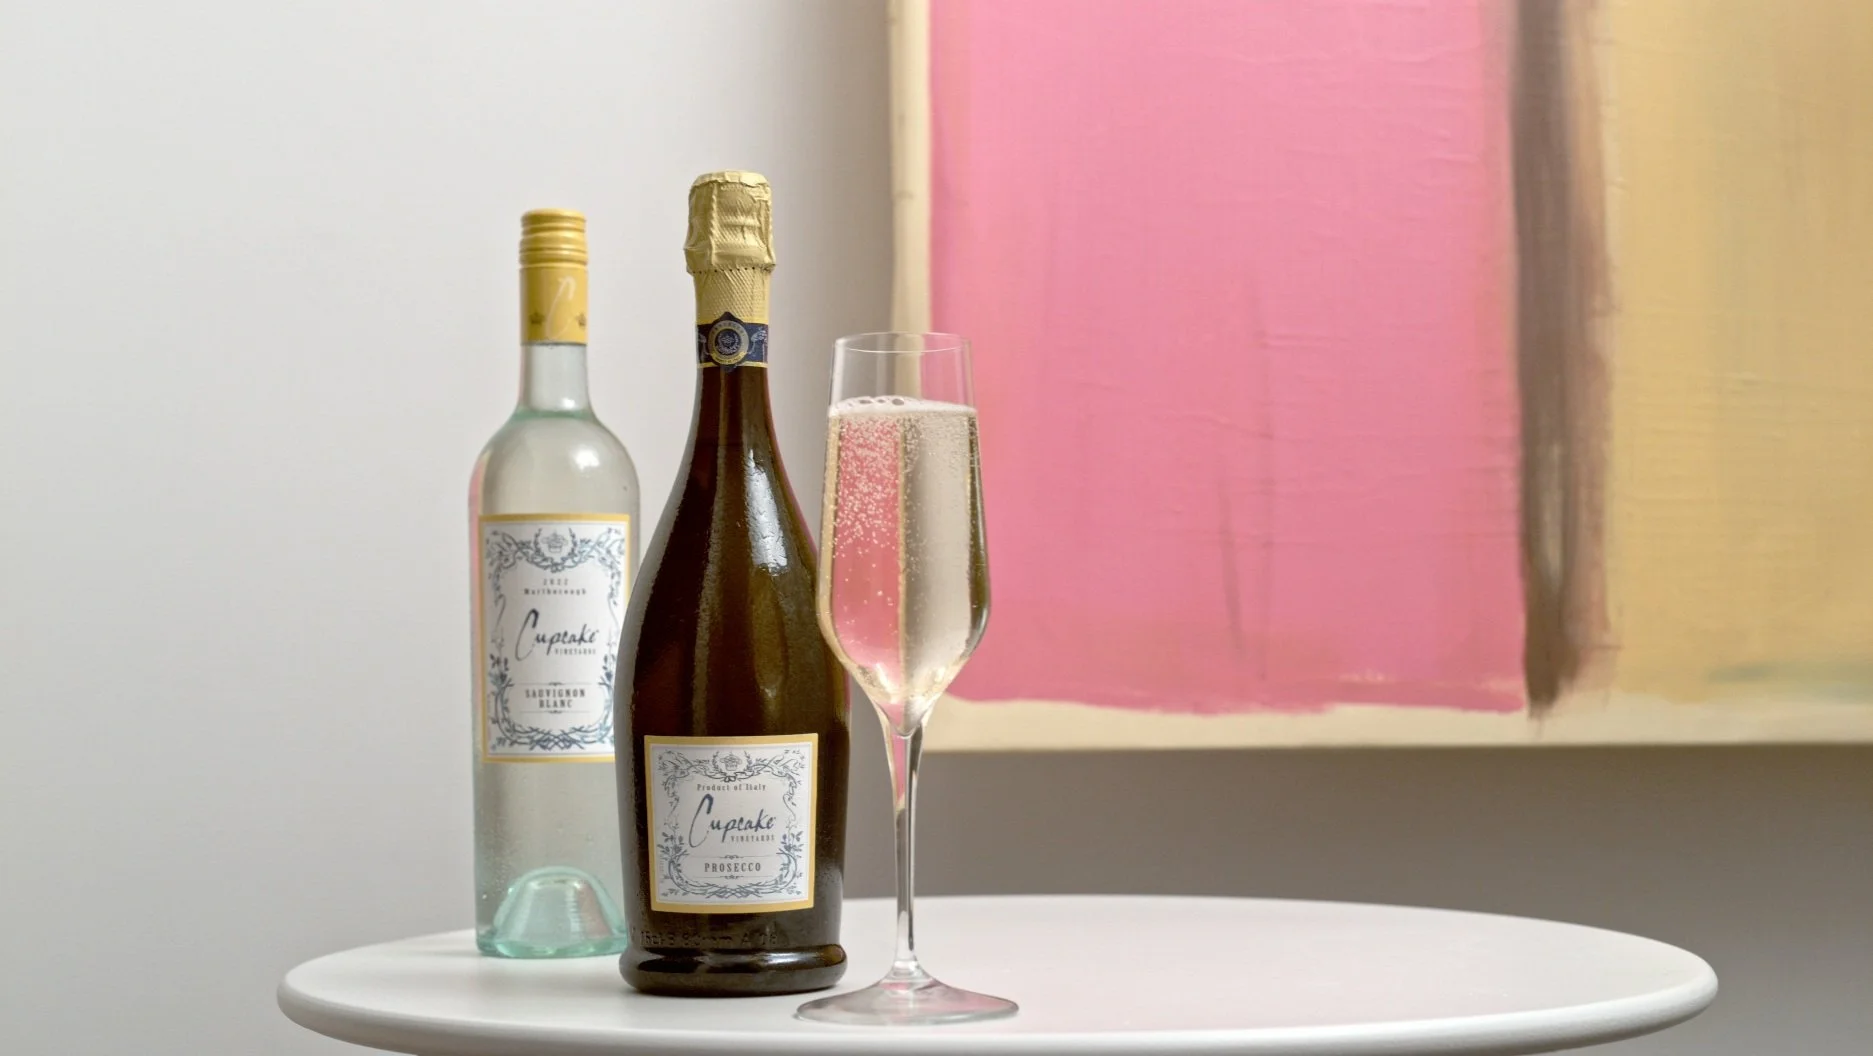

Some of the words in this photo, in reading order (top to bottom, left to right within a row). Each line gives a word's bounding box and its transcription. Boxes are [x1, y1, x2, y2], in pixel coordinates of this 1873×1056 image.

[515, 608, 598, 661] Cupcake
[525, 688, 586, 698] SAUVIGNON
[539, 699, 573, 709] BLANC
[696, 783, 730, 791] Product
[733, 783, 742, 791] of
[745, 783, 766, 792] Italy
[688, 793, 775, 848] Cupcake
[731, 834, 775, 842] VINEYARDS
[704, 862, 761, 873] PROSECCO
